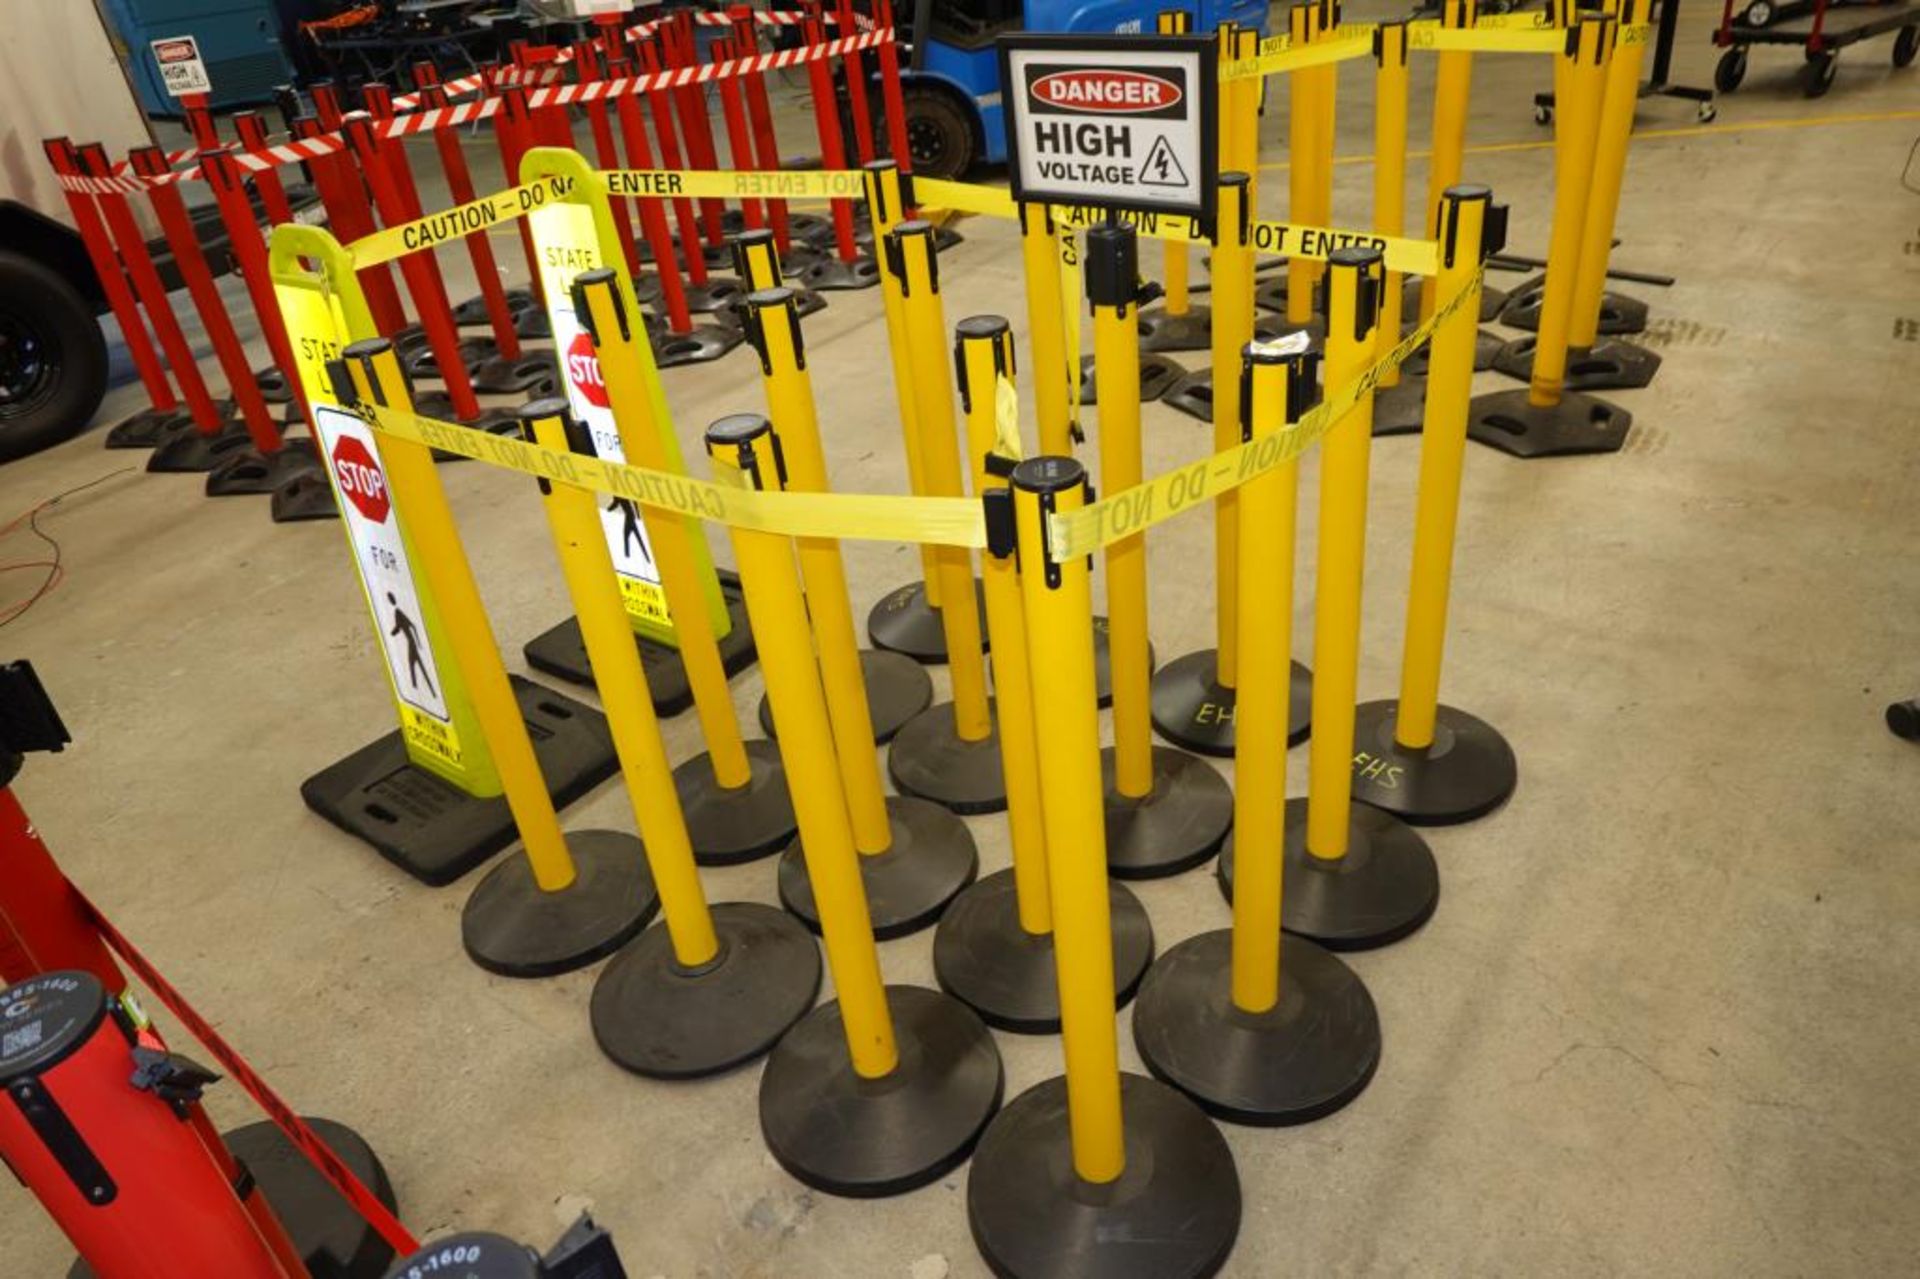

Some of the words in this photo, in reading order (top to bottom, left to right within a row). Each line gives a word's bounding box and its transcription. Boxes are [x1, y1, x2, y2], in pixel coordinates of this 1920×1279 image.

[1049, 79, 1162, 104] DANGER
[1034, 121, 1133, 158] HIGH
[1037, 161, 1135, 185] VOLTAGE
[403, 201, 497, 250] CAUTION
[518, 184, 545, 210] DO
[608, 173, 682, 194] ENTER
[546, 246, 592, 271] STATE
[337, 459, 384, 501] STOP
[371, 545, 400, 573] FOR
